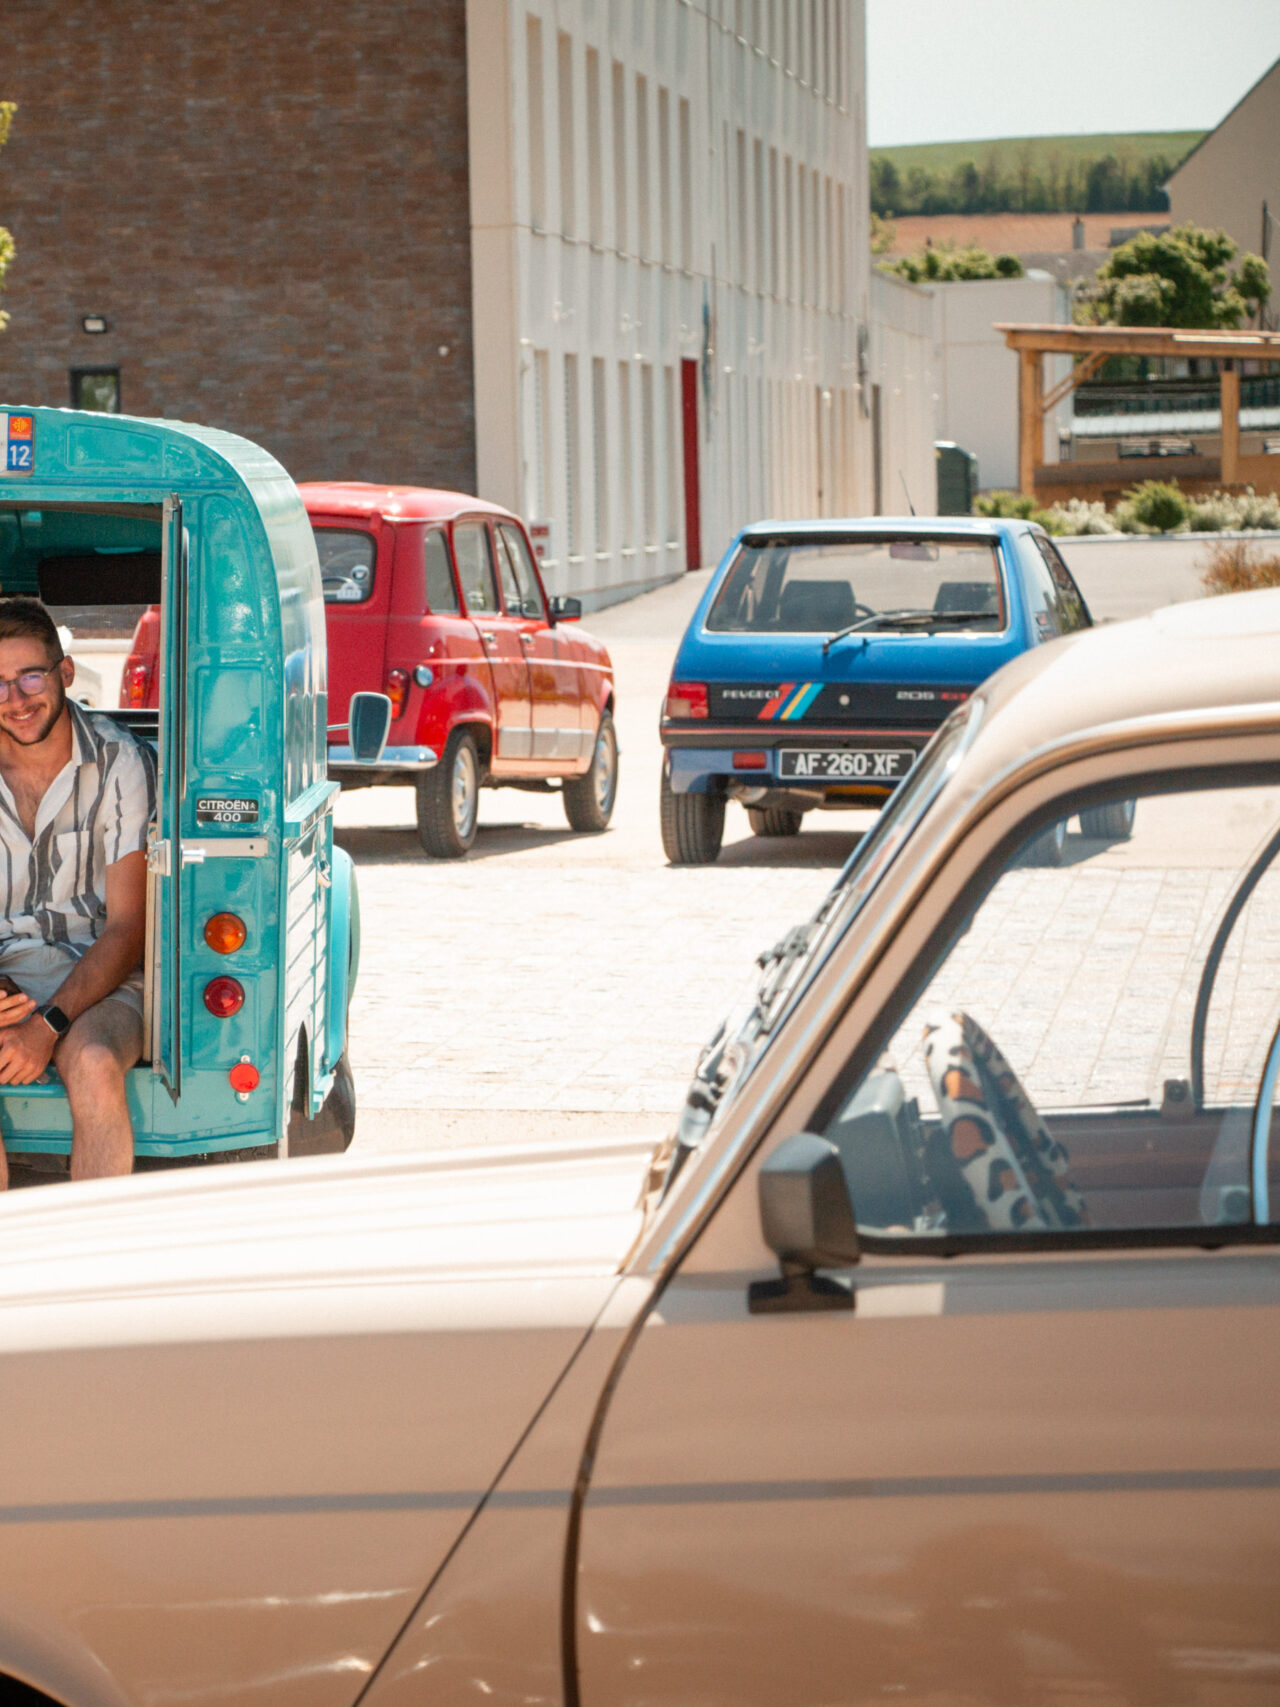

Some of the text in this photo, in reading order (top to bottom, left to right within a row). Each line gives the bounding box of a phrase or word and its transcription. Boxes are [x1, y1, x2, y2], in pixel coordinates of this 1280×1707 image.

[10, 444, 30, 466] 12
[722, 689, 781, 699] PEUGEOT
[896, 691, 935, 700] 205
[198, 799, 249, 811] CITROËN
[213, 812, 242, 822] 400
